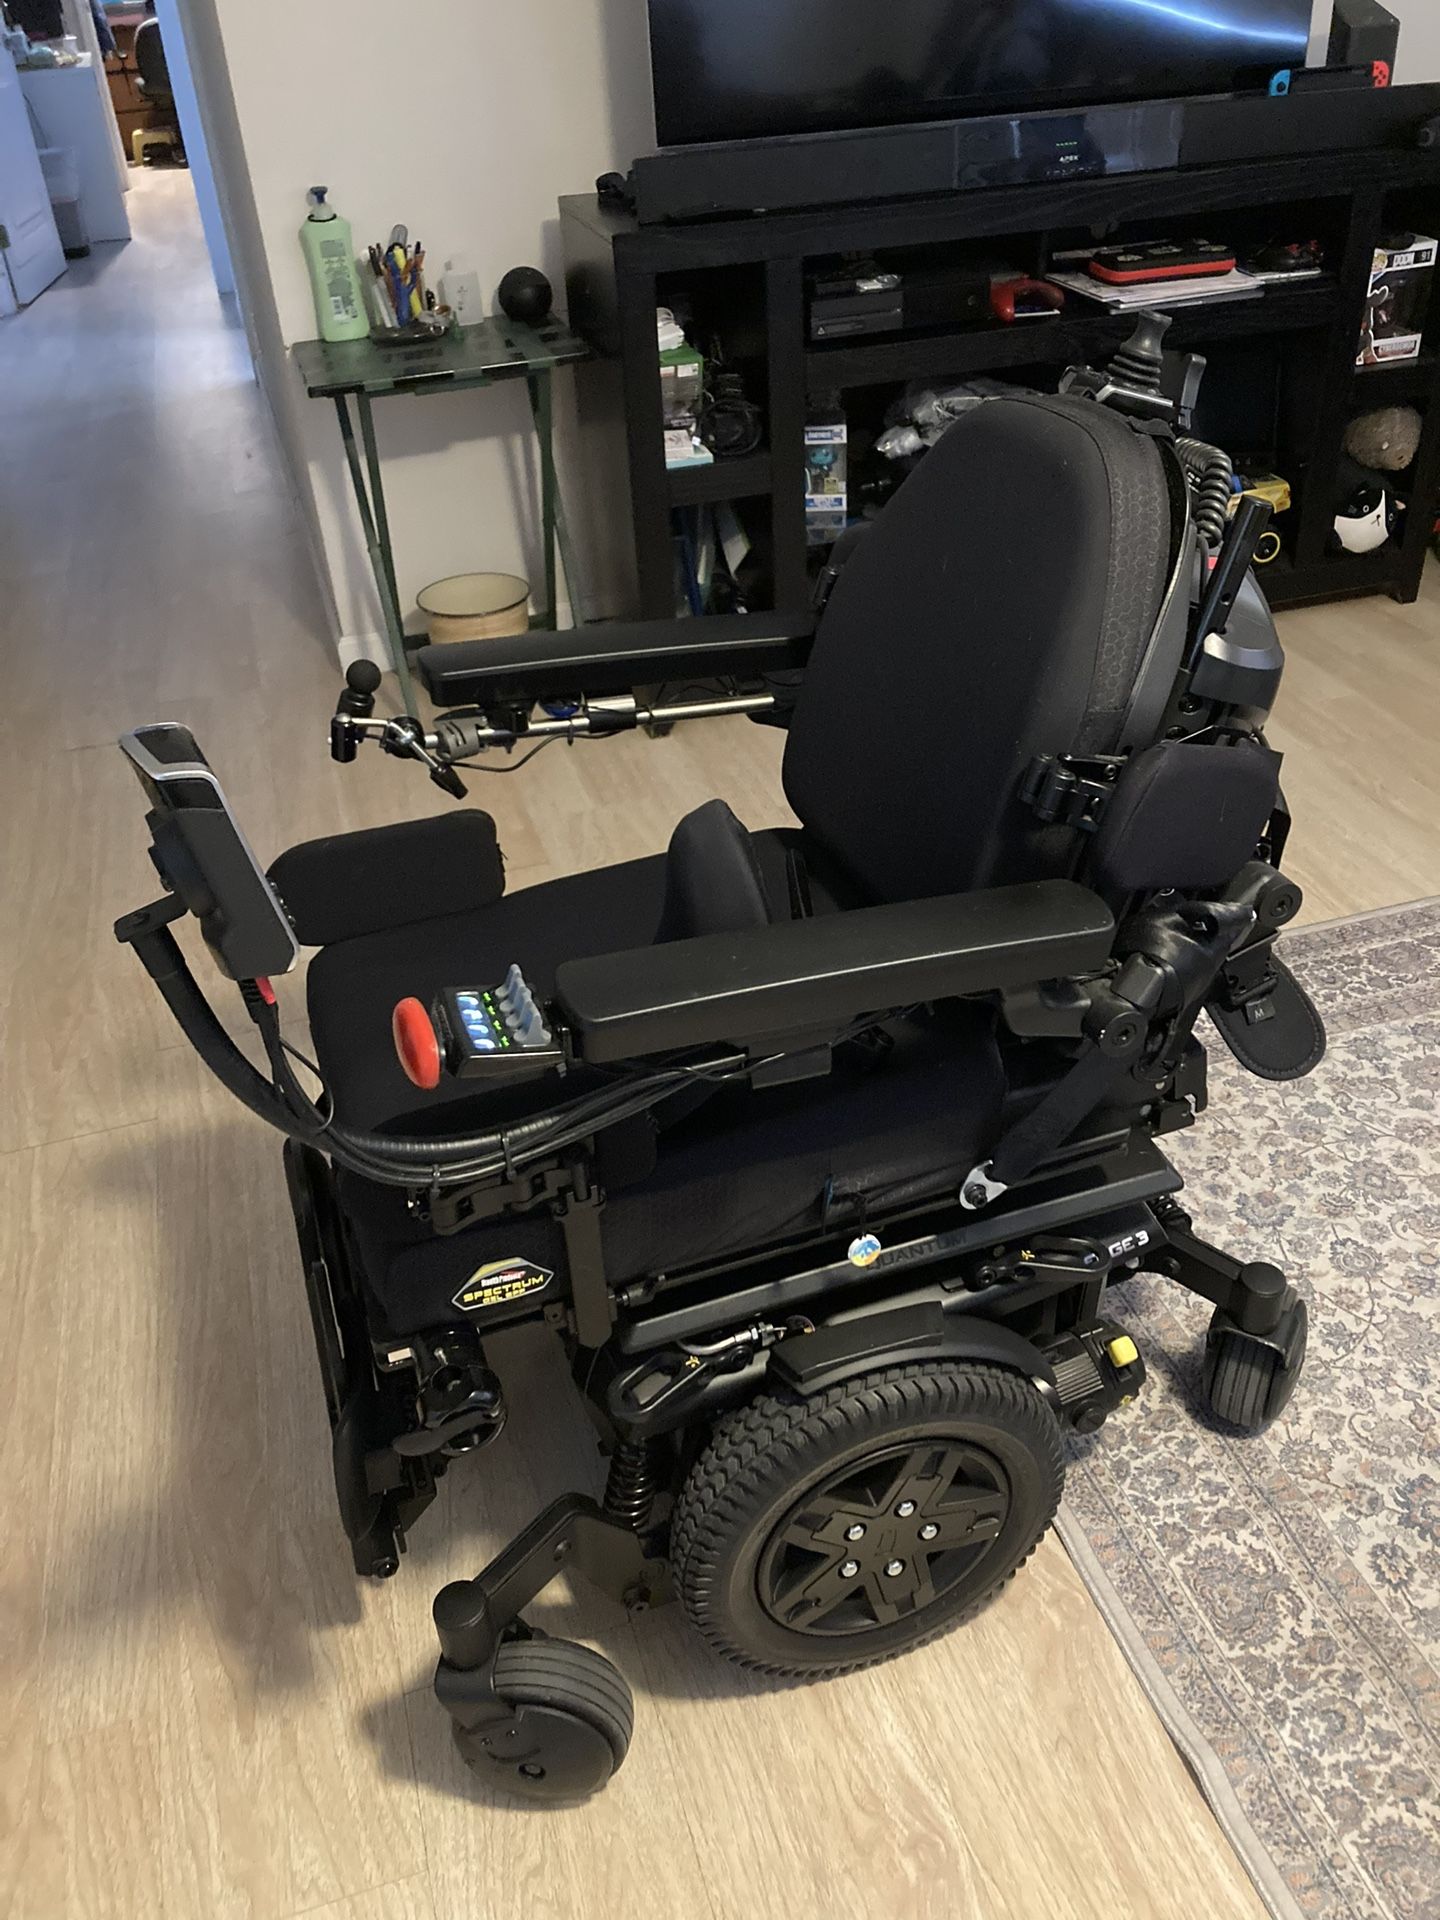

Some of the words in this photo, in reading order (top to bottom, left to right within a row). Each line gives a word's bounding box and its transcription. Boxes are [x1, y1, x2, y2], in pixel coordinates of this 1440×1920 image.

[1420, 250, 1431, 261] 91
[1135, 1230, 1149, 1246] 3
[463, 1274, 544, 1303] SPECTRUM
